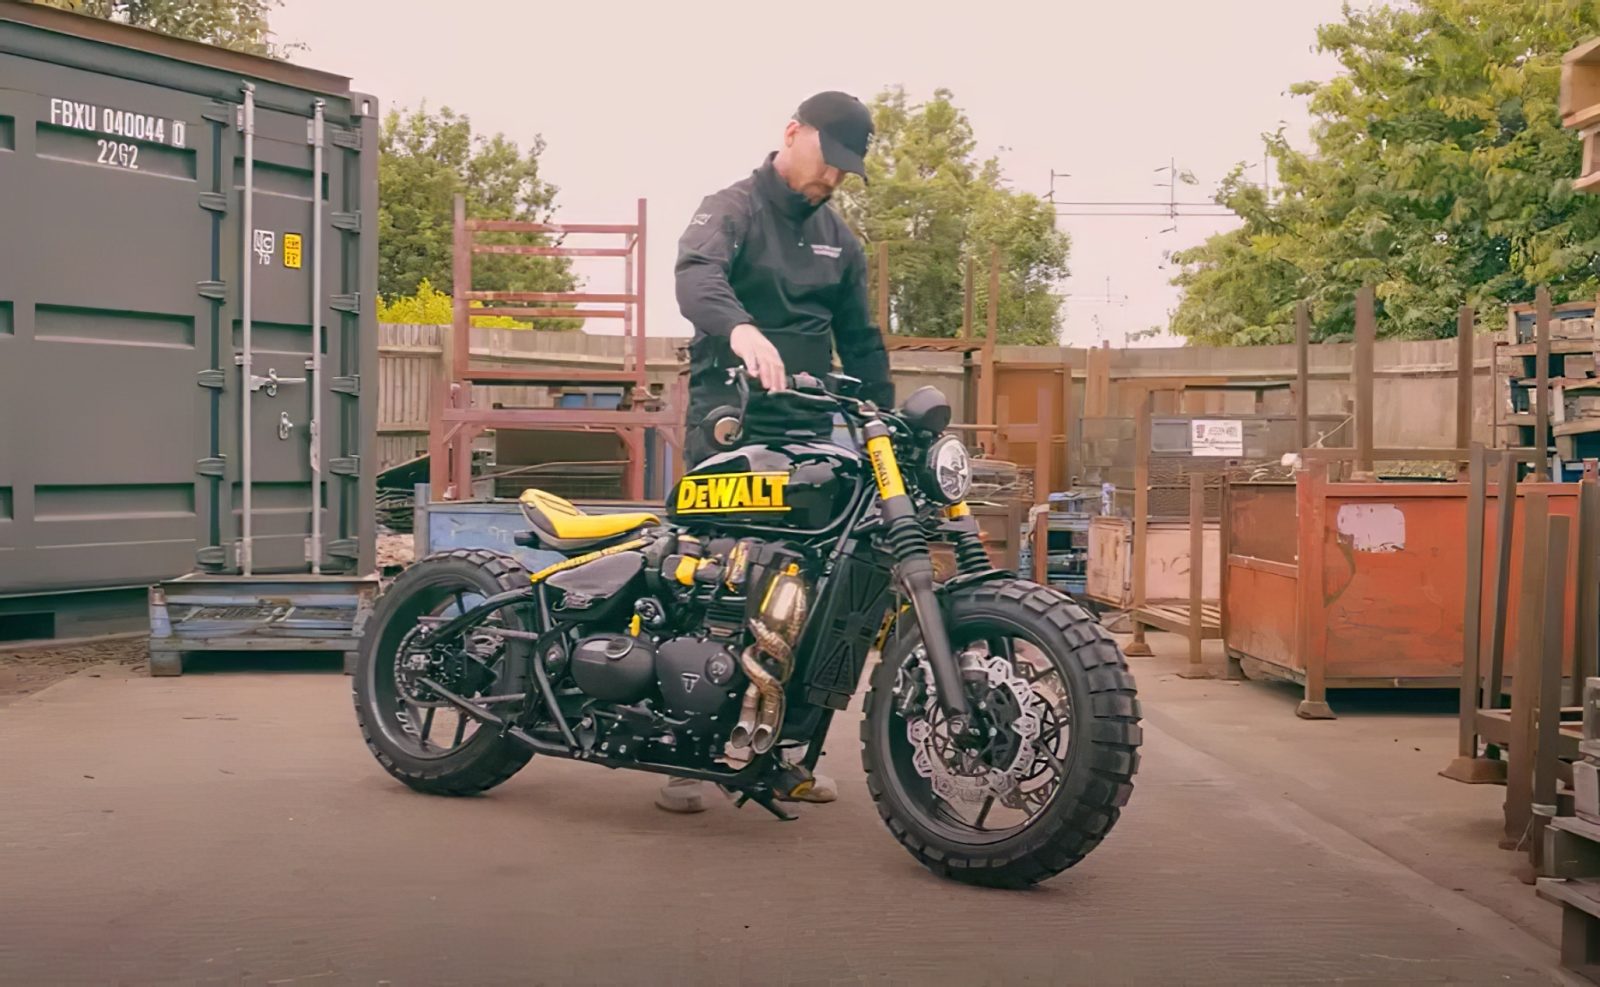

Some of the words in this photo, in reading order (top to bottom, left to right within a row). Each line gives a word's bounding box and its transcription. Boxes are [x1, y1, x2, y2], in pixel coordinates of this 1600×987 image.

[50, 98, 96, 131] FBXU
[103, 108, 165, 143] 040044
[677, 476, 790, 510] DeWALT
